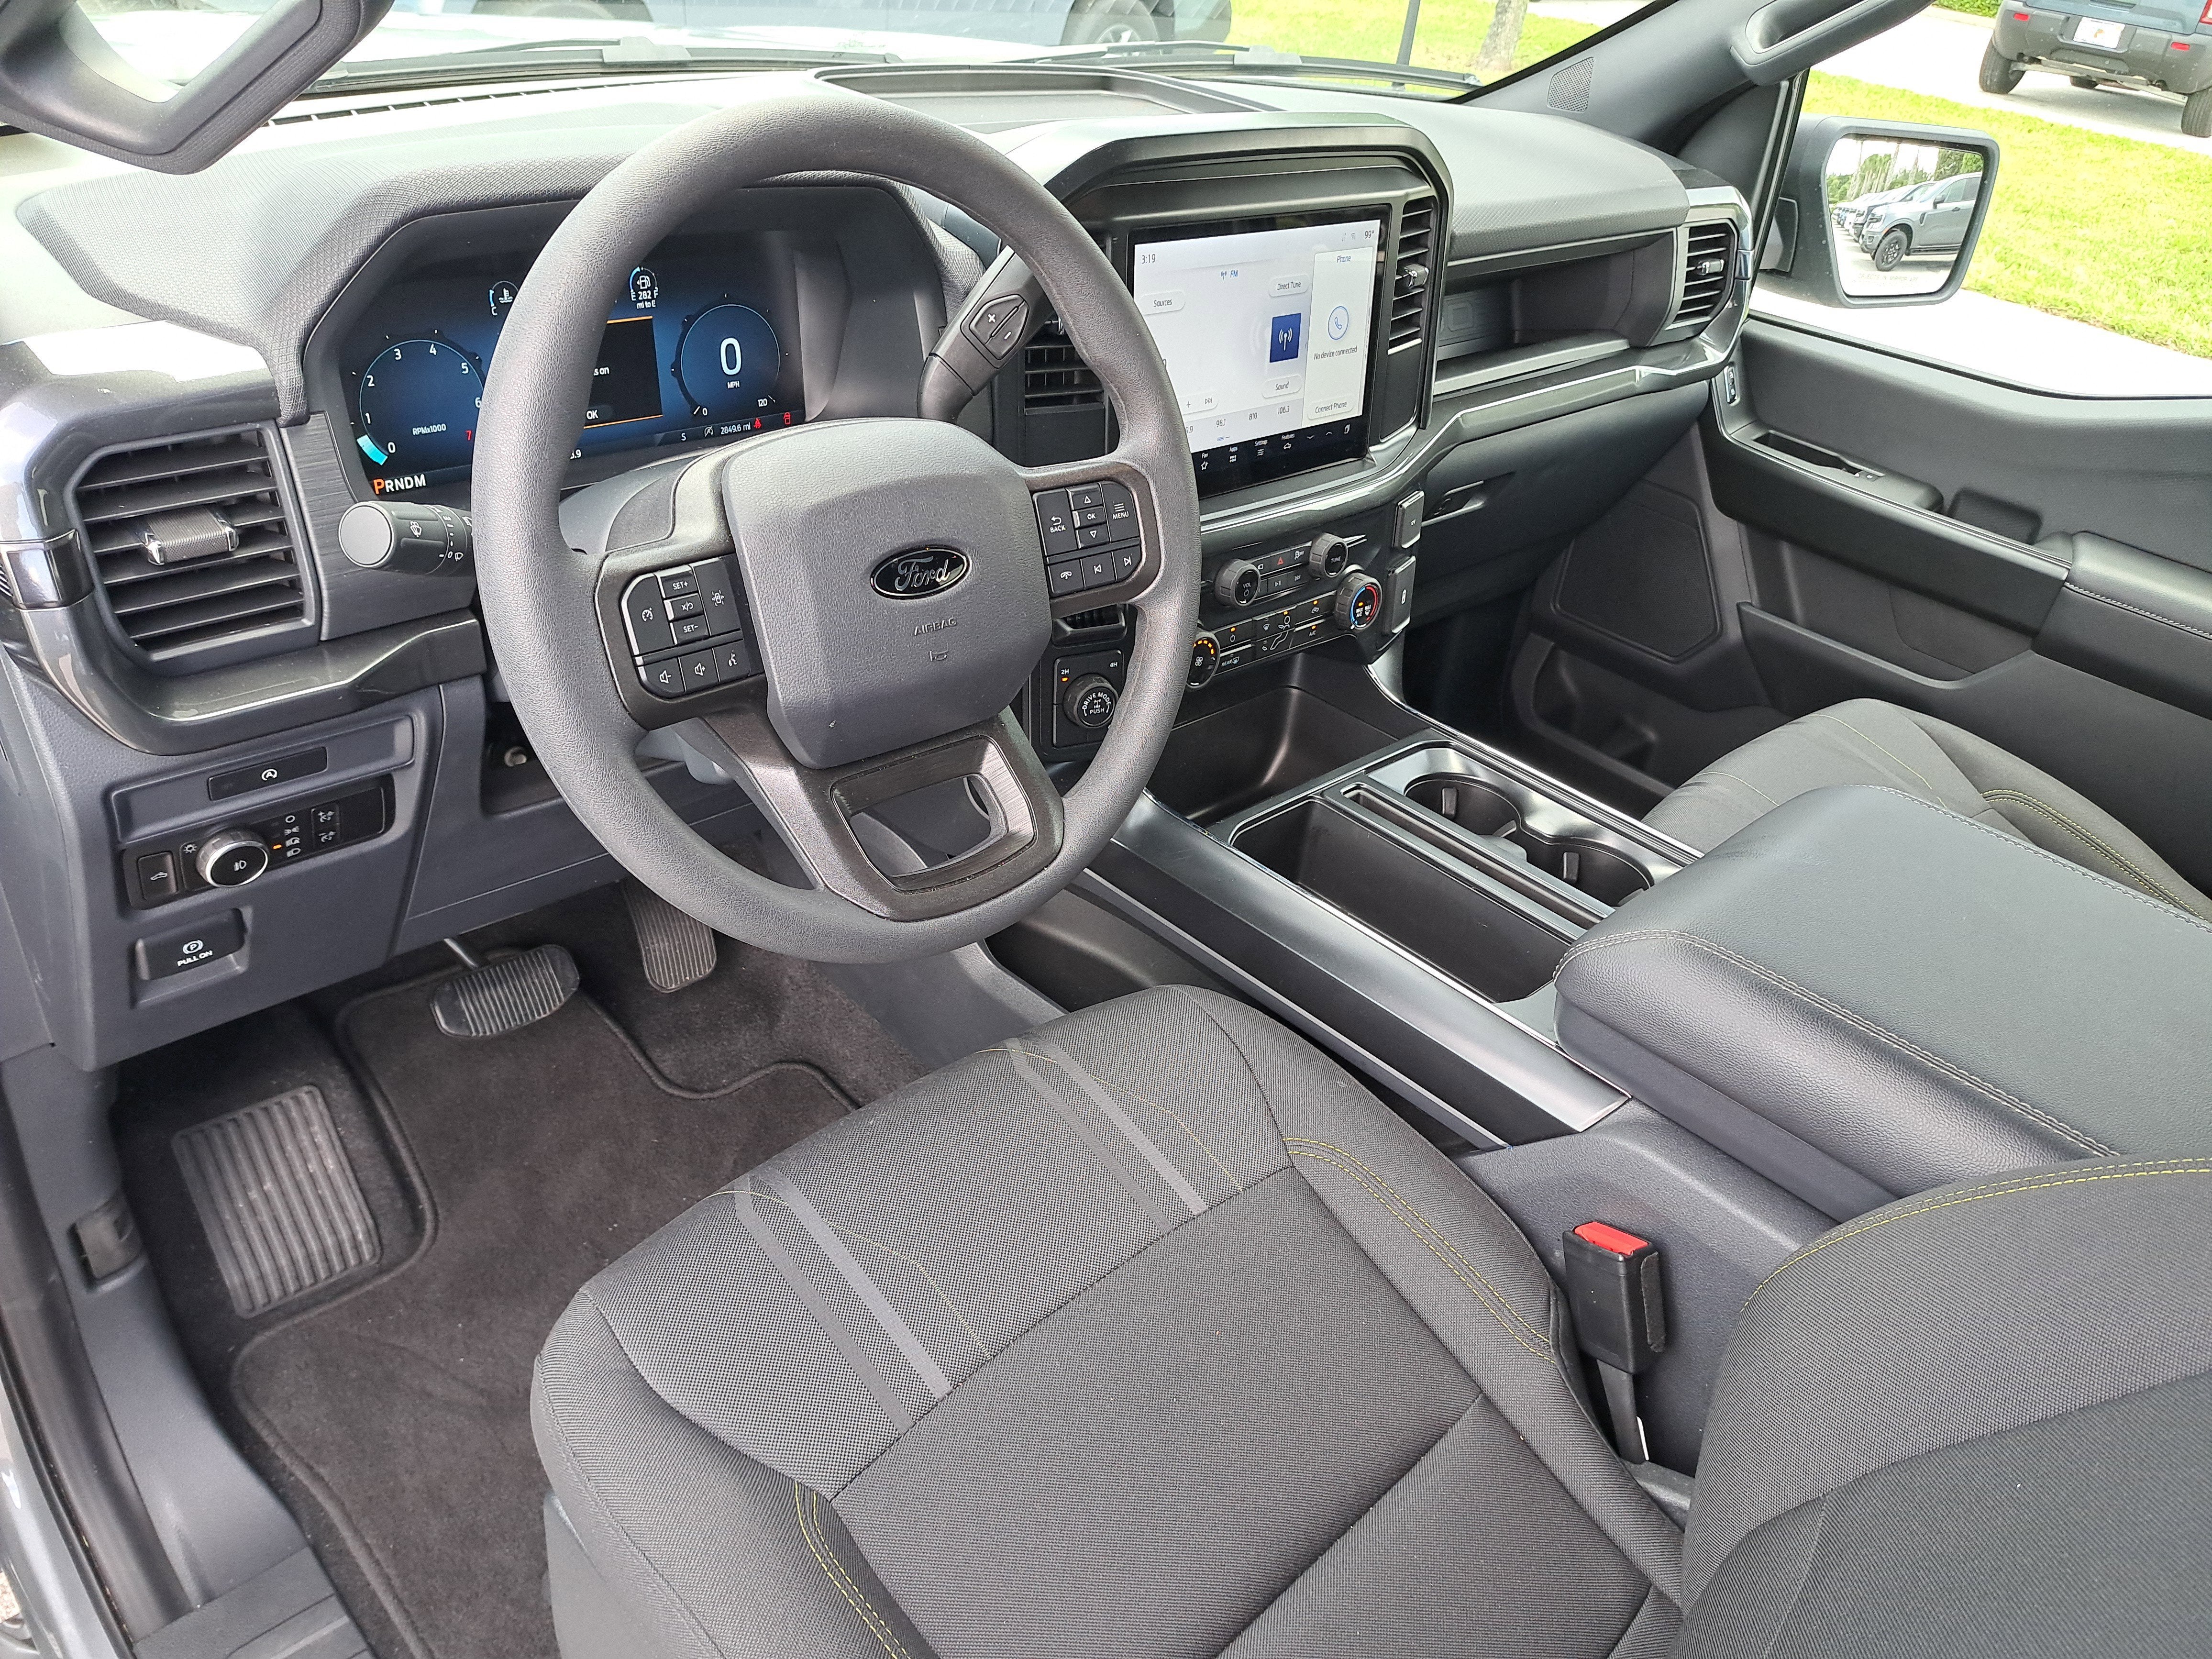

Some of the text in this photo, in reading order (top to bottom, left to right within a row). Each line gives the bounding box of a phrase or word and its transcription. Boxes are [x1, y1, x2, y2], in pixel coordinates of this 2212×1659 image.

[1141, 254, 1156, 264] 3:19
[1230, 270, 1238, 278] FM
[638, 290, 652, 300] 282
[653, 289, 659, 299] F
[1153, 299, 1172, 307] Sources
[491, 307, 498, 316] C
[394, 348, 402, 360] 3
[429, 343, 437, 355] 4
[1321, 350, 1335, 358] device
[1335, 345, 1358, 356] connected
[720, 338, 742, 375] 0
[461, 362, 469, 374] 5
[599, 367, 609, 375] on
[366, 375, 375, 387] 2
[727, 380, 740, 389] MPH
[1275, 382, 1289, 391] Sound
[475, 397, 481, 408] 6
[757, 398, 767, 407] 120
[1315, 402, 1347, 414] Connect Phone
[586, 409, 598, 420] OK
[702, 408, 708, 416] 0
[1249, 412, 1258, 420] 810
[365, 412, 371, 424] 1
[412, 423, 446, 436] RPMx1000
[466, 430, 472, 441] 7
[681, 432, 686, 441] S
[388, 442, 396, 453] 0
[1087, 512, 1096, 520] OK
[1112, 510, 1129, 520] MENU
[1050, 524, 1067, 533] BACK
[895, 555, 951, 591] Ford
[914, 618, 956, 636] AIRBAG
[1082, 692, 1111, 709] DRIVE MODE
[177, 950, 213, 967] PULL ON
